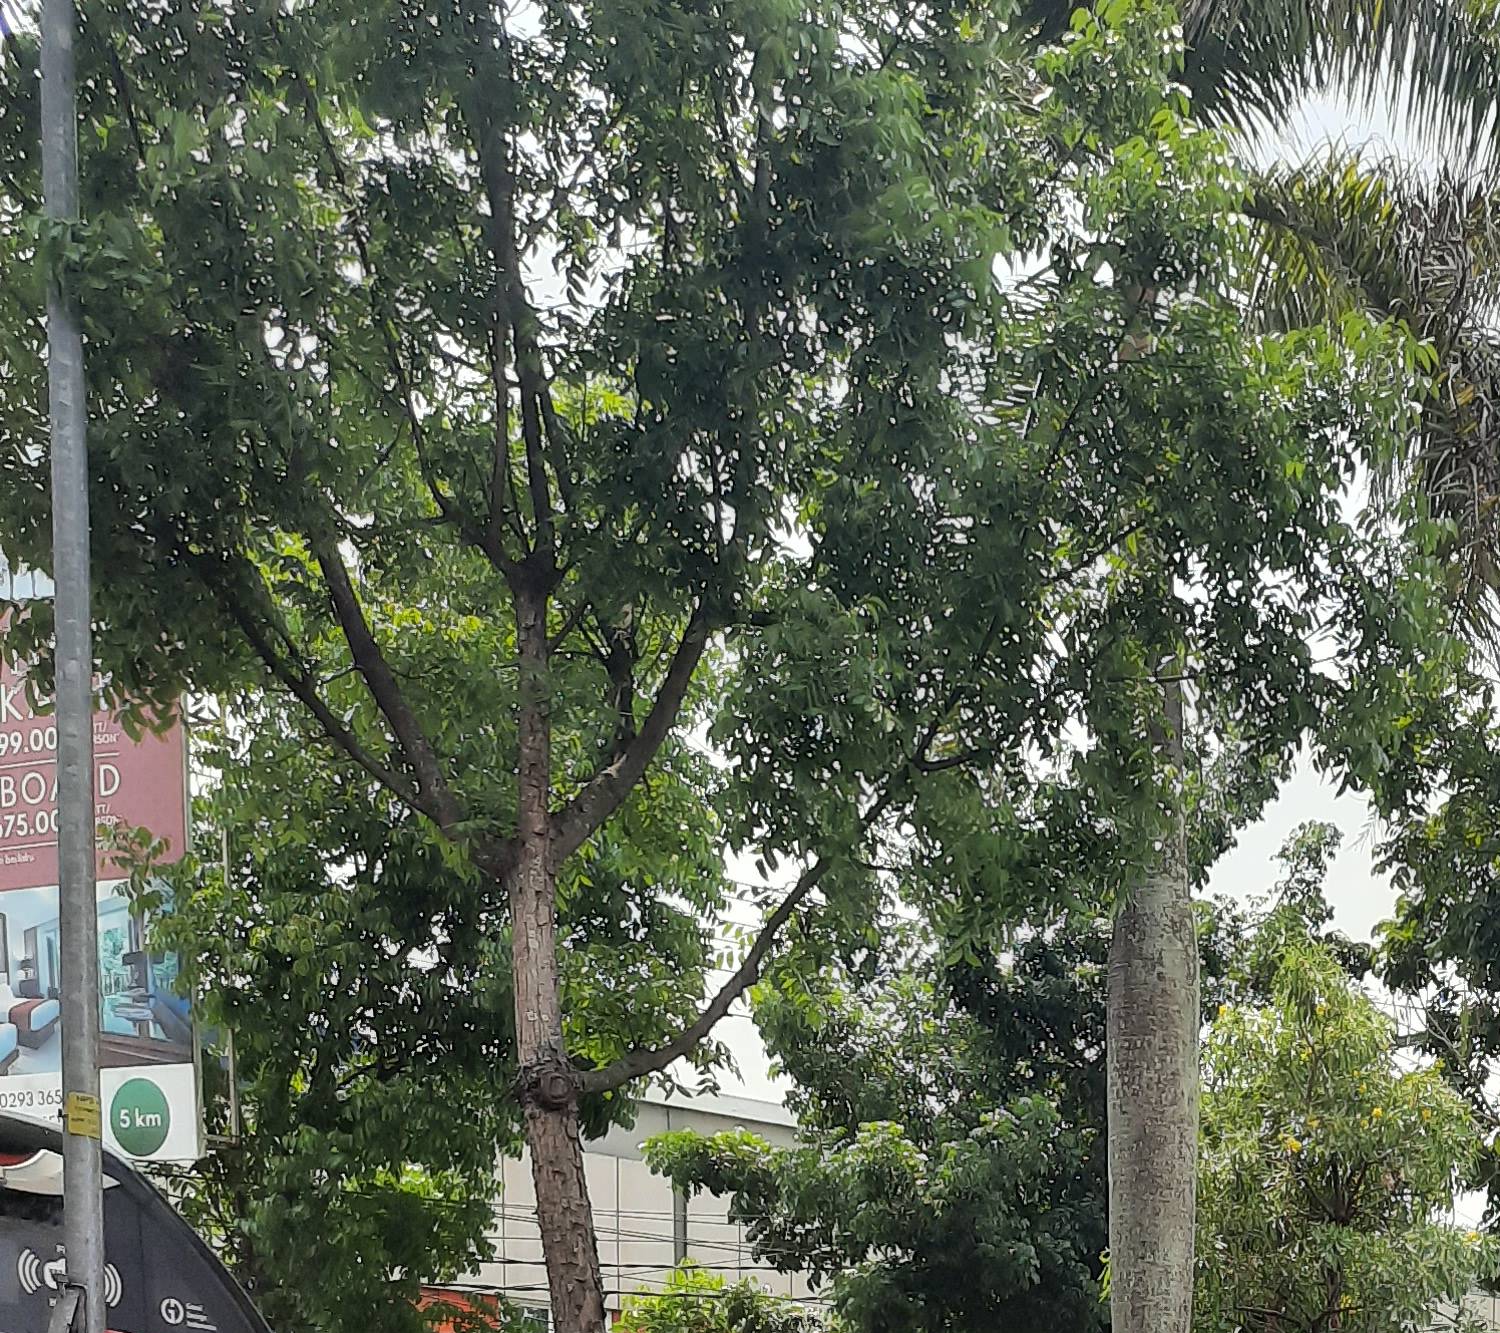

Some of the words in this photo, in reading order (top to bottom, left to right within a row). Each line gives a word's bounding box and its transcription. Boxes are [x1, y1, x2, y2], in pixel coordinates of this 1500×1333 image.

[0, 726, 57, 756] 99.00
[0, 809, 58, 838] 75.00
[120, 1109, 131, 1128] 5
[135, 1107, 162, 1128] km
